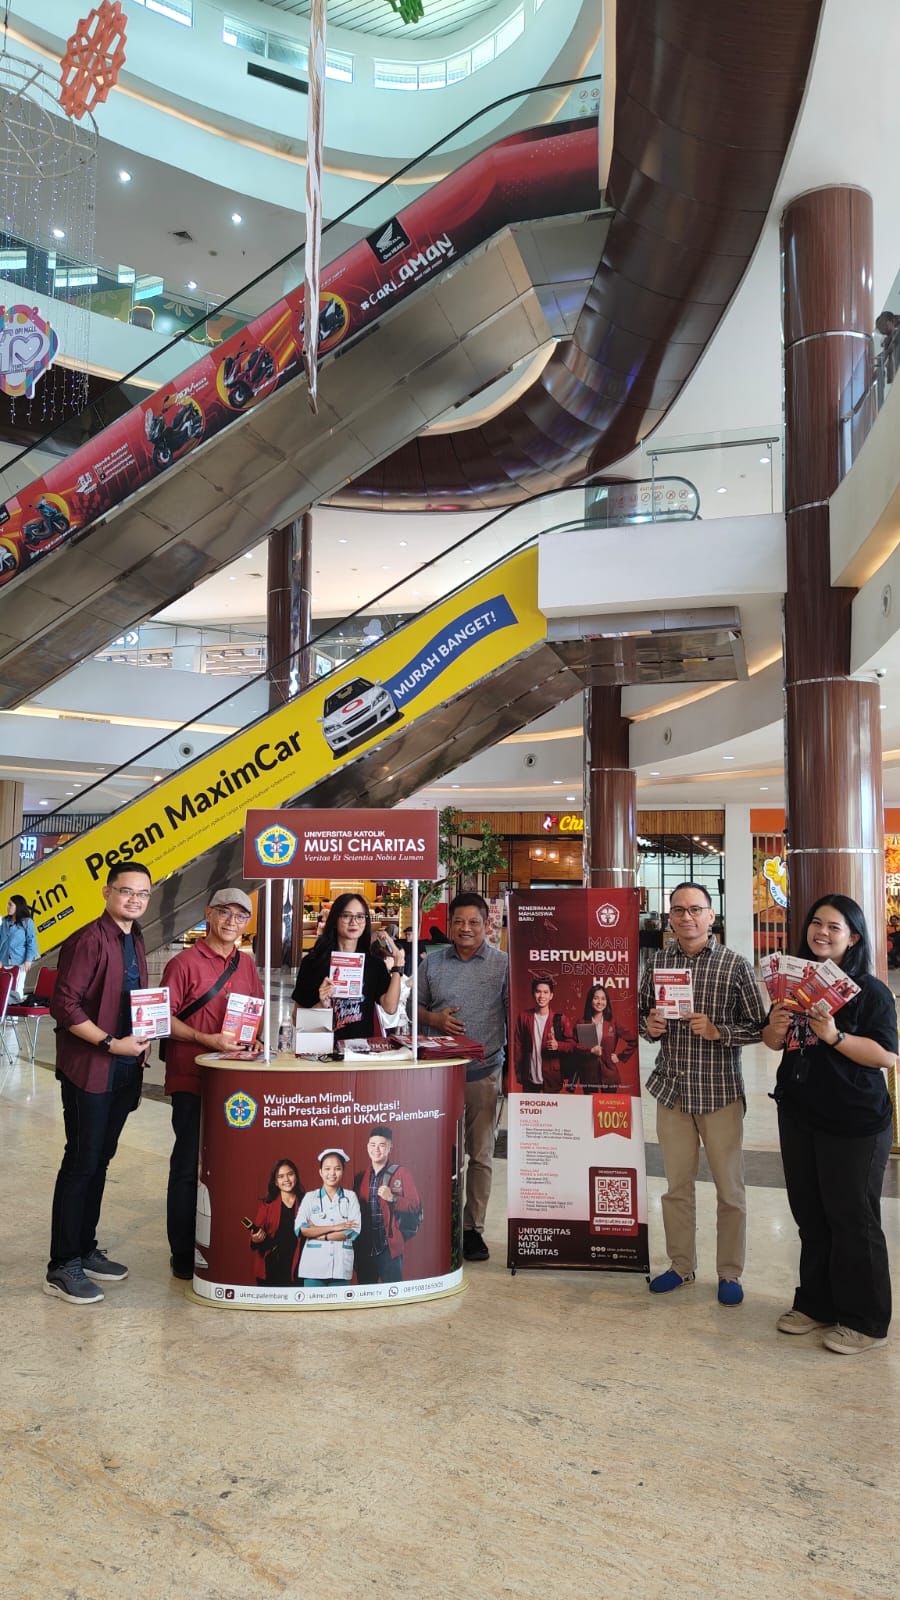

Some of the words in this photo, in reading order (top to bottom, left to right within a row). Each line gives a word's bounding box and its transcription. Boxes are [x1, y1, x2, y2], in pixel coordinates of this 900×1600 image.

[394, 653, 441, 699] MURAH
[437, 611, 497, 657] BANGET!
[85, 821, 165, 881] Pesan
[164, 730, 302, 830] MaximCar
[304, 839, 343, 853] MUSI
[347, 838, 426, 853] CHARITAS
[304, 854, 331, 862] Veritas
[398, 853, 424, 861] Lumen
[588, 936, 629, 950] MARI
[529, 949, 629, 962] BERTUMBUH
[561, 962, 630, 976] DENGAN
[592, 976, 630, 989] HATI
[263, 1094, 317, 1106] Wujudkan
[319, 1091, 355, 1103] Mimpi,
[263, 1106, 287, 1117] Raih
[288, 1104, 330, 1116] Prestasi
[332, 1103, 351, 1114] dan
[353, 1100, 400, 1114] Reputasi!
[263, 1117, 308, 1128] Bersama
[310, 1116, 340, 1127] Kami,
[341, 1114, 351, 1125] di
[353, 1113, 387, 1125] UKMC
[597, 1111, 628, 1129] 100%
[518, 1227, 571, 1236] UNIVERSITAS
[518, 1234, 553, 1242] KATOLIK
[518, 1241, 539, 1249] MUSI
[518, 1248, 559, 1256] CHARITAS
